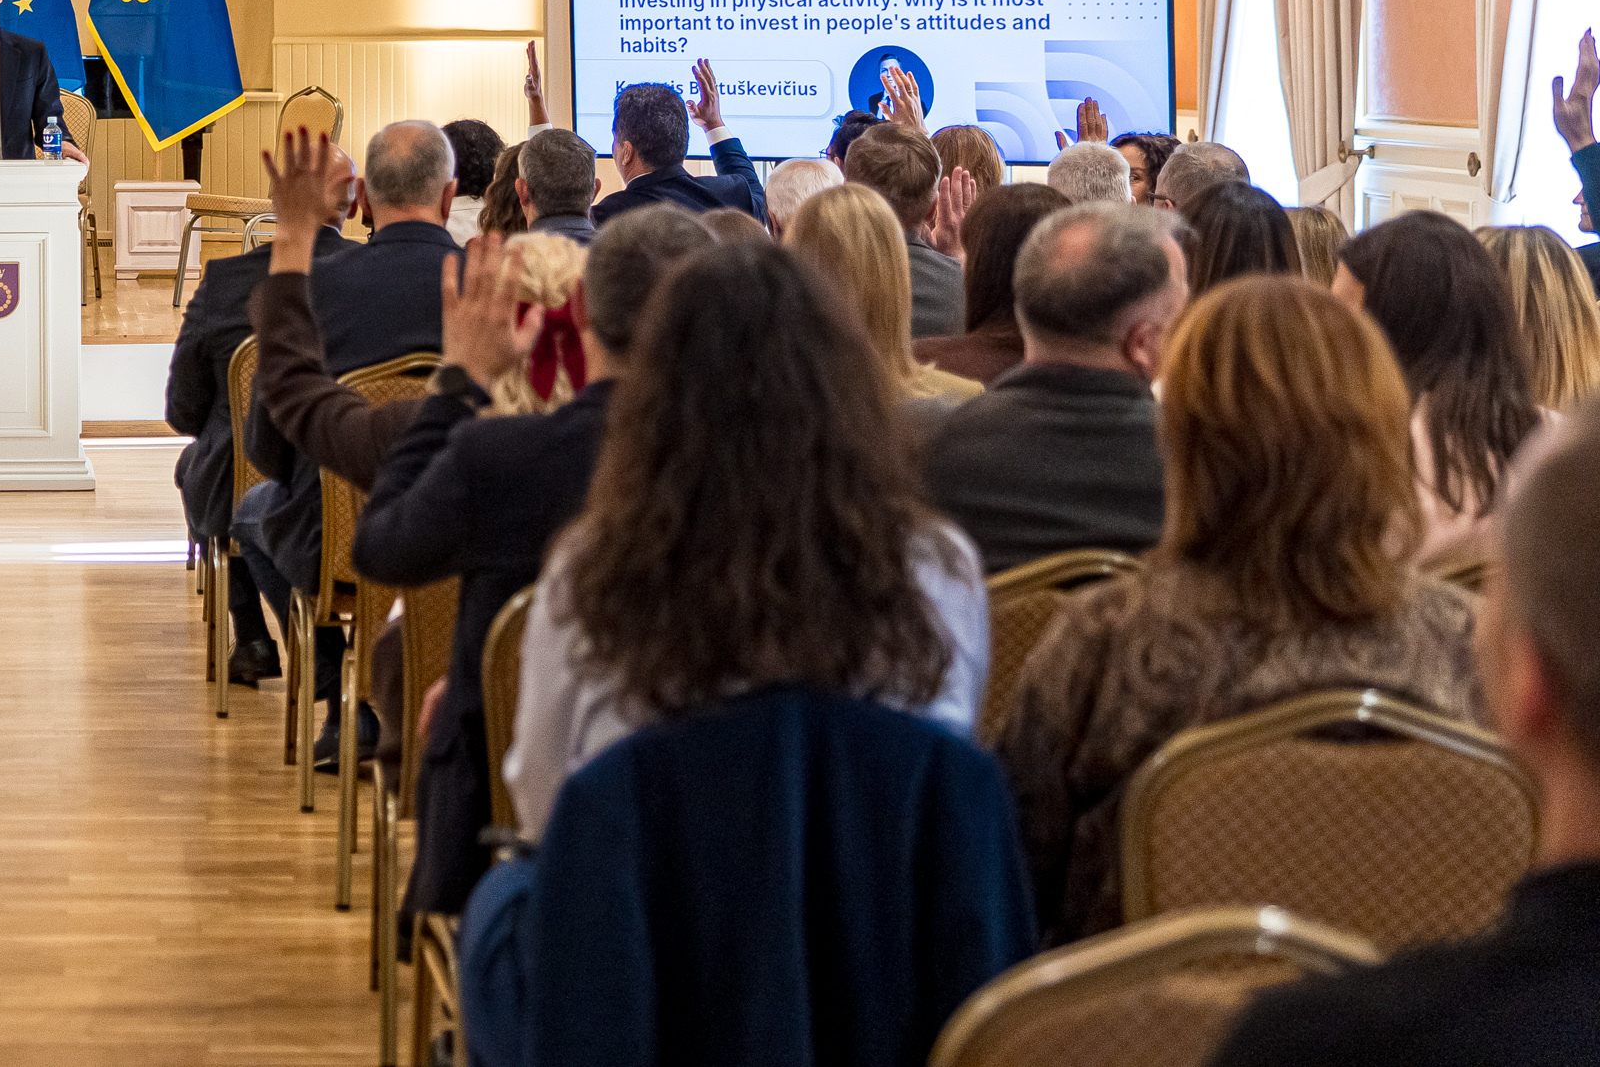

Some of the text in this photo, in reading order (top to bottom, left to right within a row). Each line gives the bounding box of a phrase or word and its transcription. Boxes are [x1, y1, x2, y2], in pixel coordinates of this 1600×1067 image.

[620, 14, 1050, 34] important to invest in people's attitudes and
[620, 37, 688, 53] habits?
[690, 80, 817, 96] Btuškevičius
